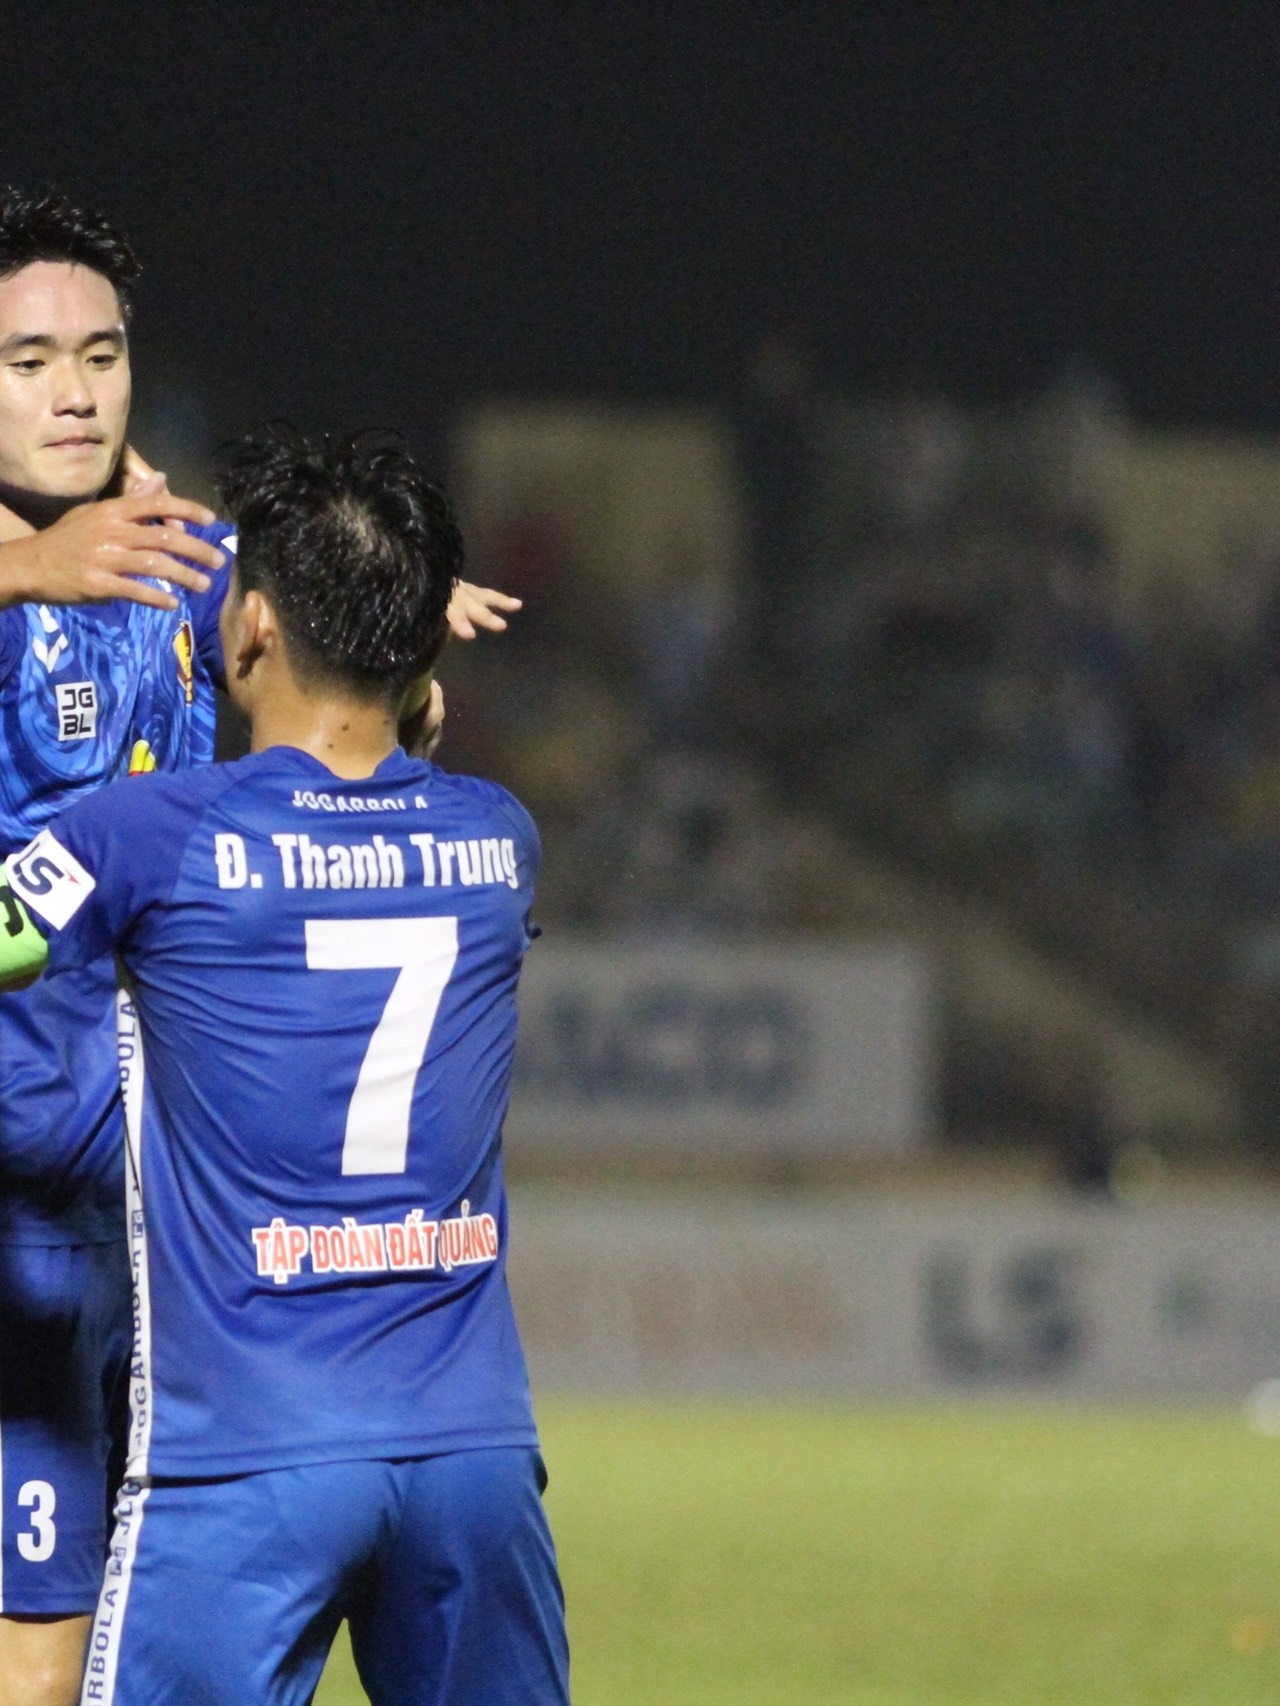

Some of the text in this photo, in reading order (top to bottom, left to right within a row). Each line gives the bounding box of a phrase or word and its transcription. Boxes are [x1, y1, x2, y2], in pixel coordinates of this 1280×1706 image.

[61, 687, 94, 710] JG
[63, 713, 91, 735] BL
[12, 841, 65, 896] LS
[214, 832, 519, 889] Đ. Thanh Trung
[304, 916, 459, 1176] 7
[252, 1199, 498, 1284] TẬP ĐOÀN ĐẤT QUẢNG
[16, 1480, 56, 1562] 3
